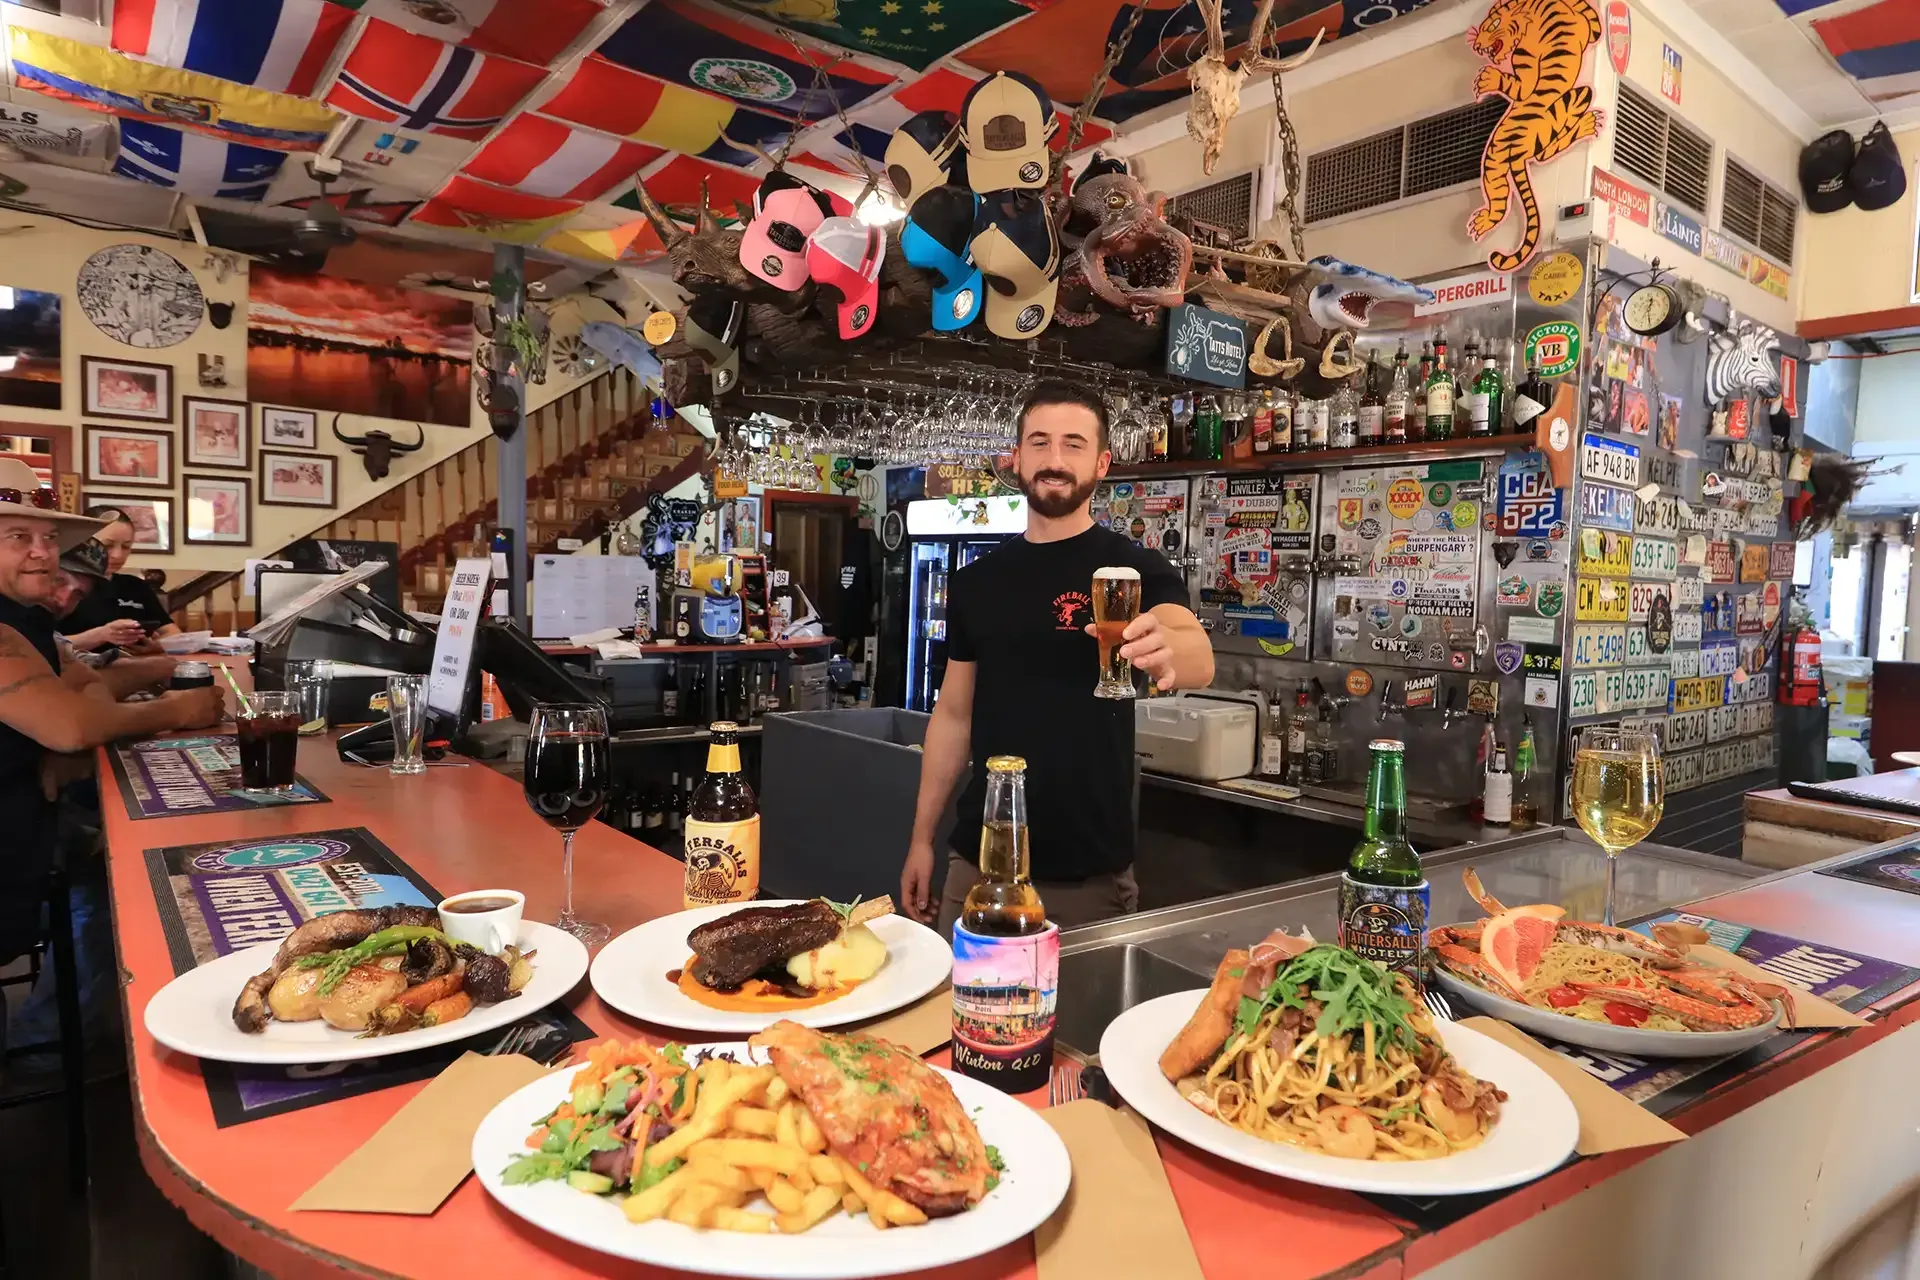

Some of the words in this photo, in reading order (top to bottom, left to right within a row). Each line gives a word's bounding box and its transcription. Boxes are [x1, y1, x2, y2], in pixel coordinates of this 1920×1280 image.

[1594, 175, 1616, 200] NORTH
[1618, 187, 1648, 214] LONDON
[1538, 291, 1568, 302] TAXI
[1527, 325, 1579, 349] VICTORIA
[1542, 343, 1561, 357] VB
[1542, 358, 1575, 374] TTER
[937, 464, 965, 478] SOLD
[1586, 450, 1600, 474] AF
[1603, 453, 1622, 479] 948
[1624, 459, 1637, 482] BK
[1230, 483, 1265, 495] LINVILLE?
[1504, 472, 1557, 498] CGA
[1245, 499, 1278, 507] DUBBO
[1388, 492, 1421, 503] XXXX
[1589, 487, 1612, 517] KEL
[1503, 503, 1556, 530] 522
[1406, 543, 1466, 553] BURPENGARY
[776, 572, 786, 583] 39
[1052, 591, 1091, 607] FIREBALL
[1407, 606, 1473, 617] NOONAMAH?
[1536, 657, 1549, 668] 31
[1404, 676, 1436, 691] HAHN
[1573, 679, 1594, 707] 230
[204, 874, 284, 913] WHEN
[703, 887, 742, 899] Winton
[1346, 928, 1419, 950] TATTERSALLS
[1358, 945, 1404, 958] HOTEL
[955, 1041, 1004, 1073] Winton
[1011, 1053, 1042, 1072] QLD
